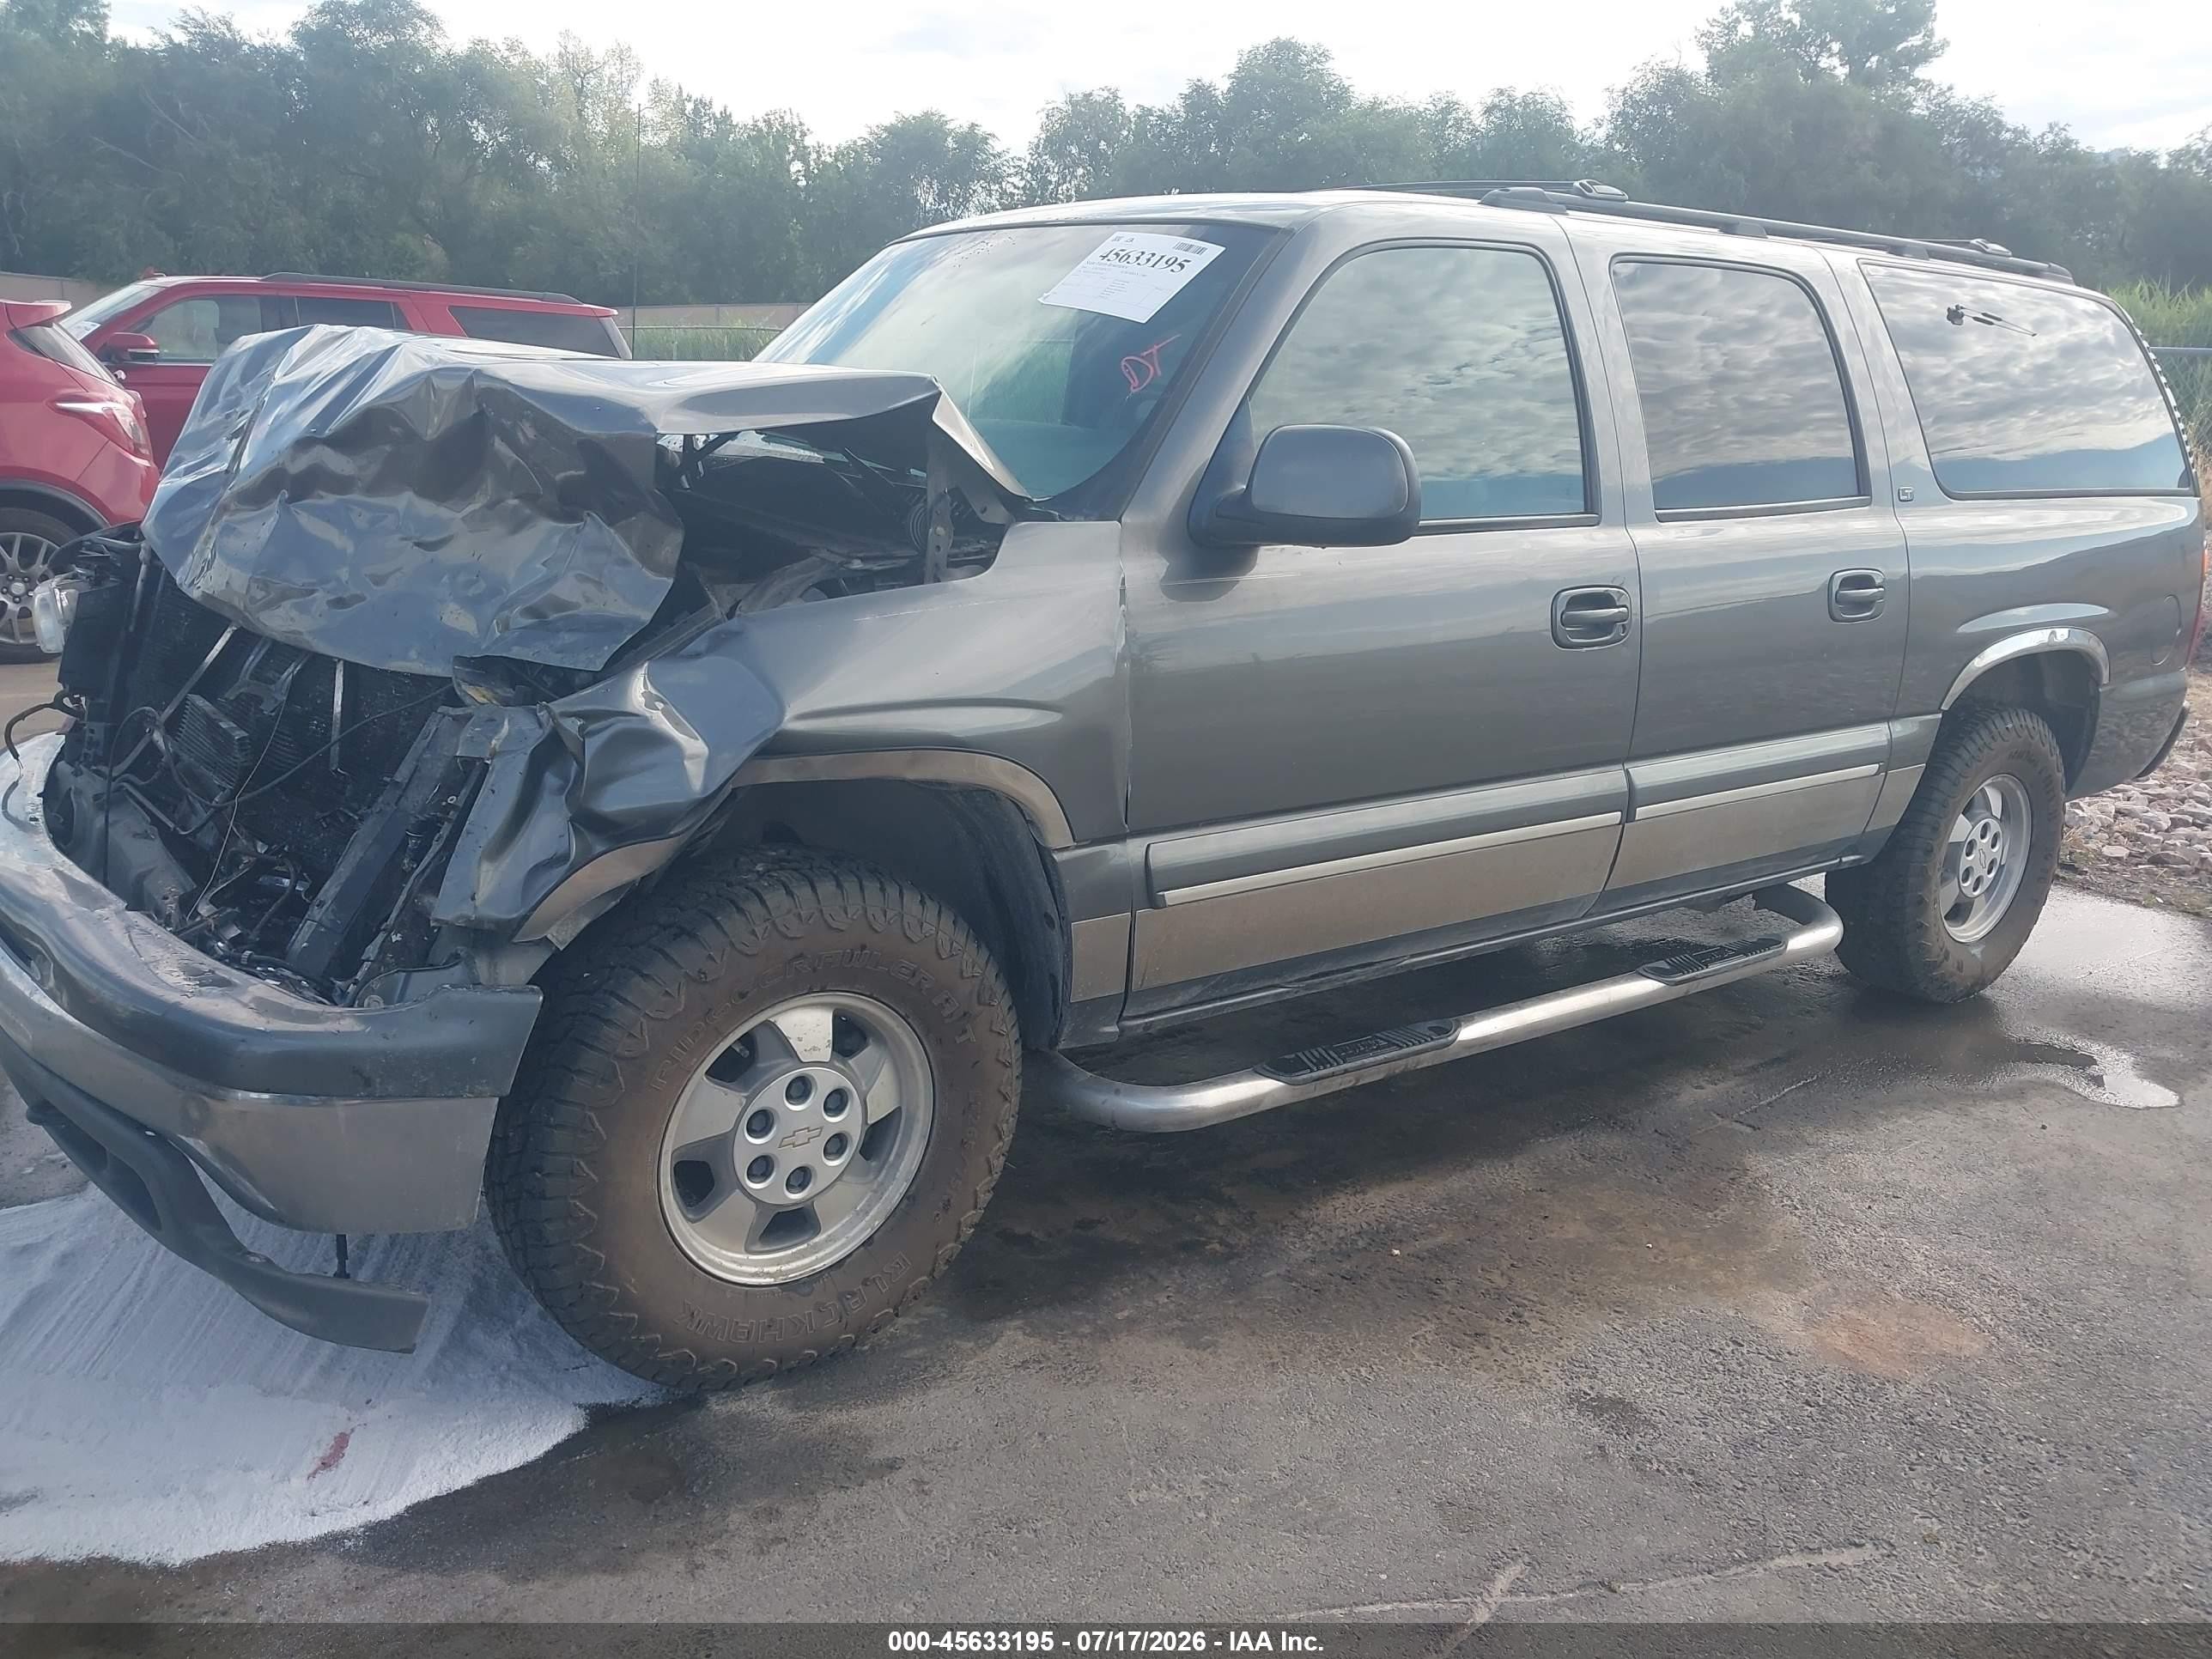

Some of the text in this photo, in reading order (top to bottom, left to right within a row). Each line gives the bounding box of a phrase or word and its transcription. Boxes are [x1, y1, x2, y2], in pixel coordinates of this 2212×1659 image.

[1099, 247, 1192, 274] 45633195
[1898, 487, 1914, 501] LT
[672, 1250, 913, 1343] BLACKHAWK
